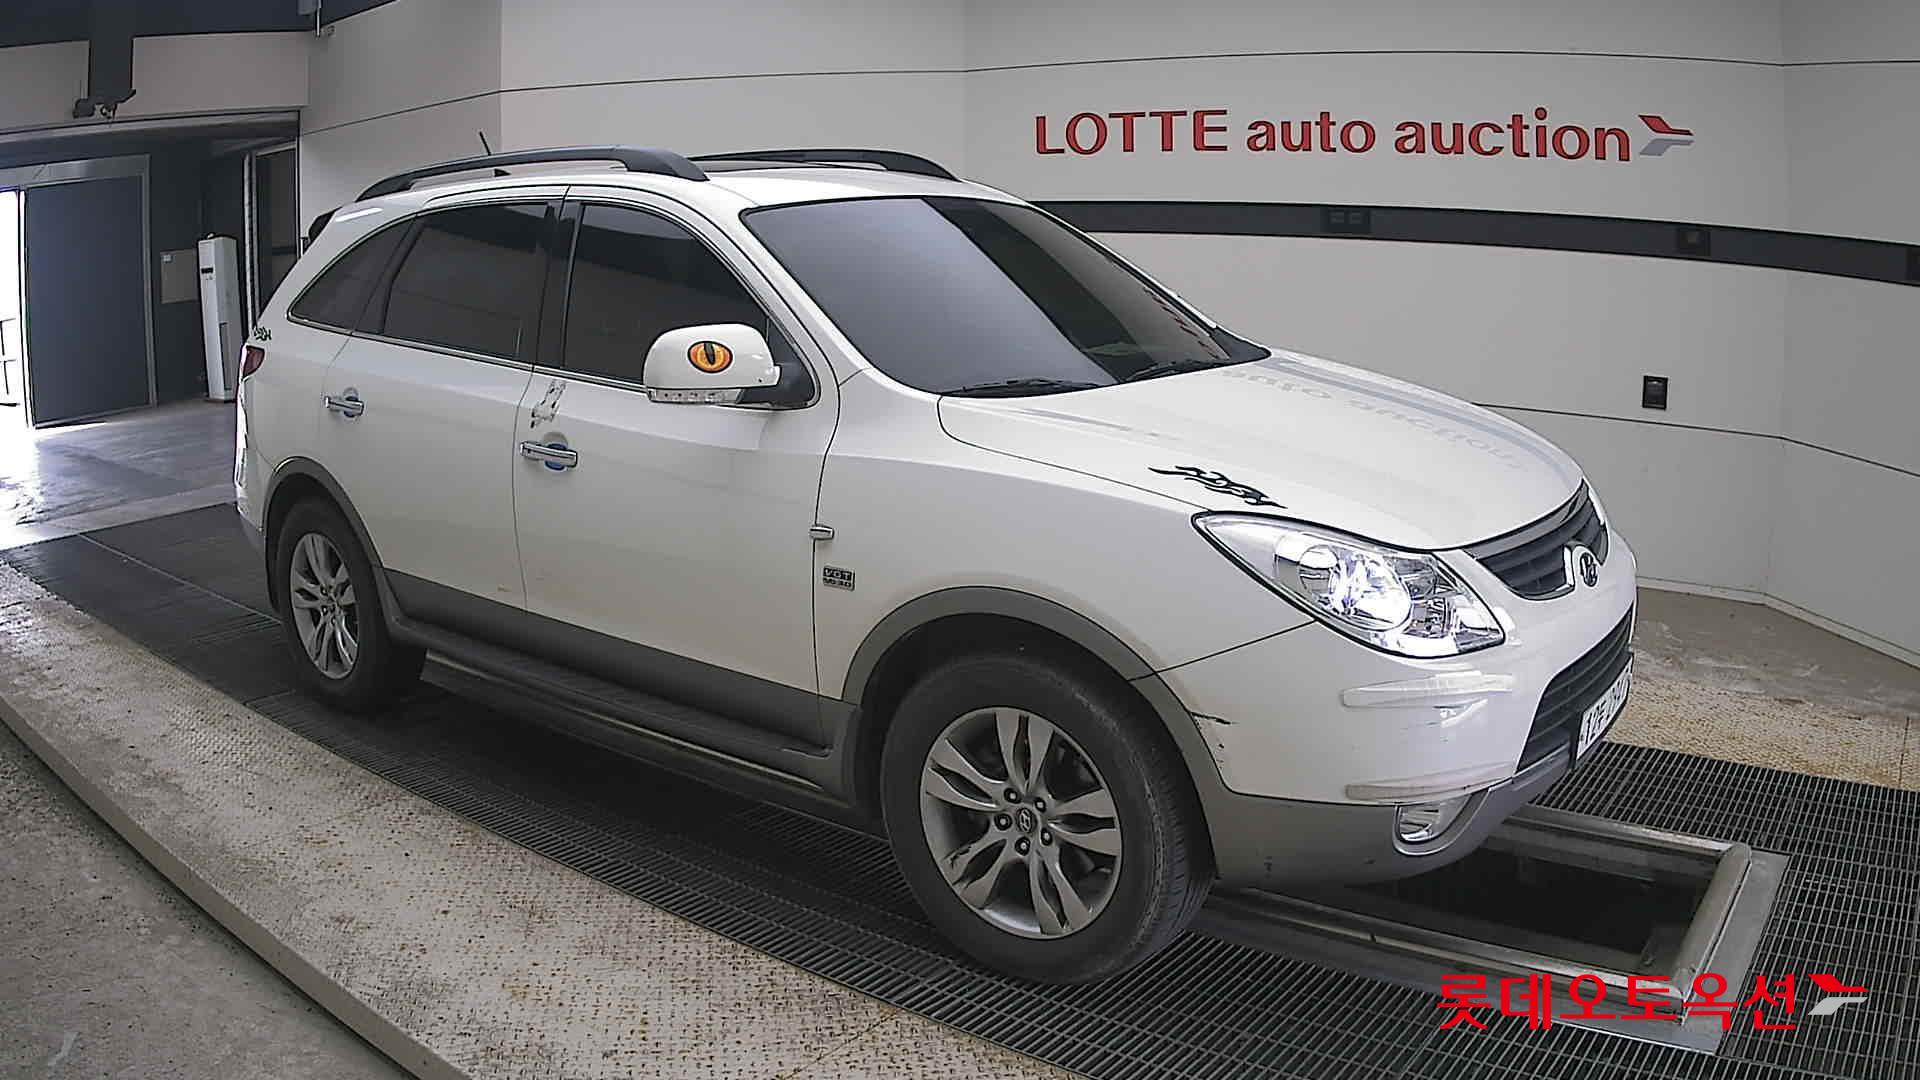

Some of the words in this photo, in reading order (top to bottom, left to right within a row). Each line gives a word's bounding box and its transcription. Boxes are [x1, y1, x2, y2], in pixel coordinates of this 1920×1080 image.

[1036, 109, 1228, 155] LOTTE
[1246, 111, 1376, 153] auto
[1394, 107, 1631, 162] auction
